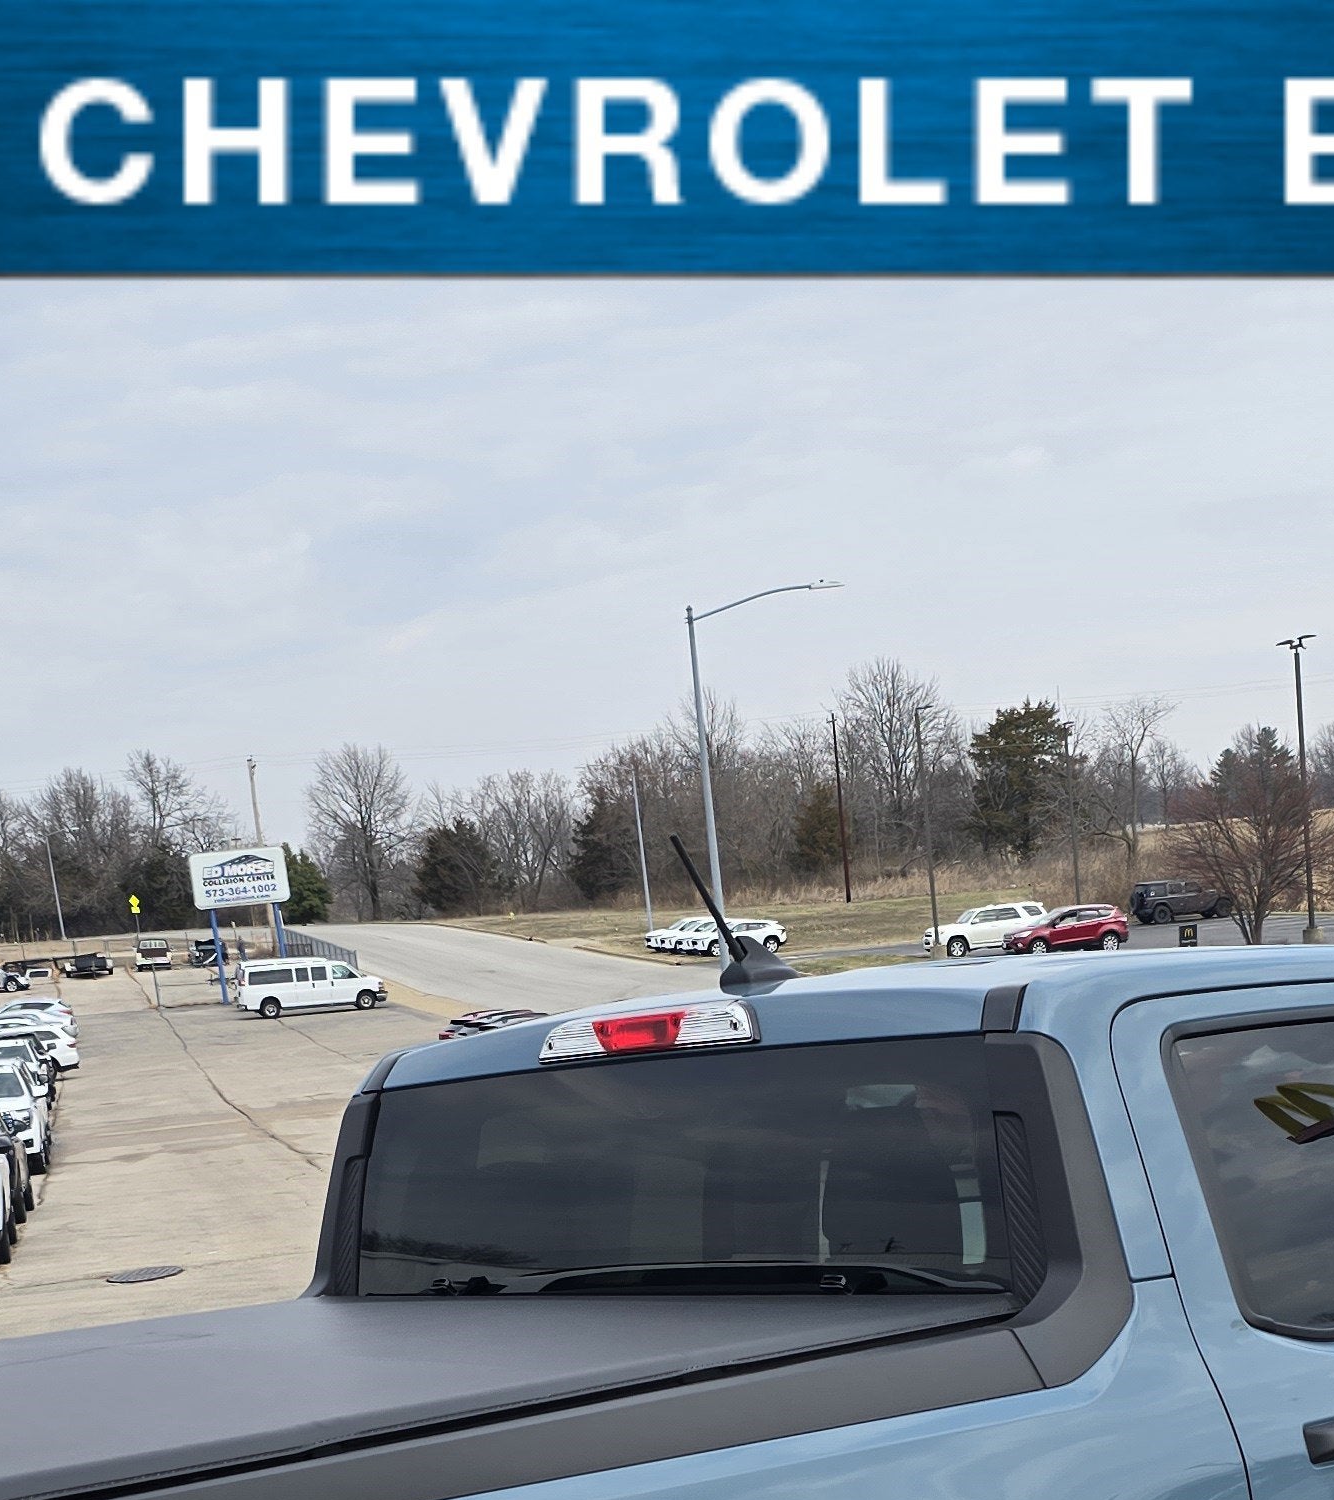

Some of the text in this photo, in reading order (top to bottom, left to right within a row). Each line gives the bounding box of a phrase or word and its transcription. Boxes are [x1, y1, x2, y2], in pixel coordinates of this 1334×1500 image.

[203, 860, 274, 880] ED MORSE
[203, 874, 275, 887] COLLISION CENTER
[205, 884, 277, 898] 573-364-1002
